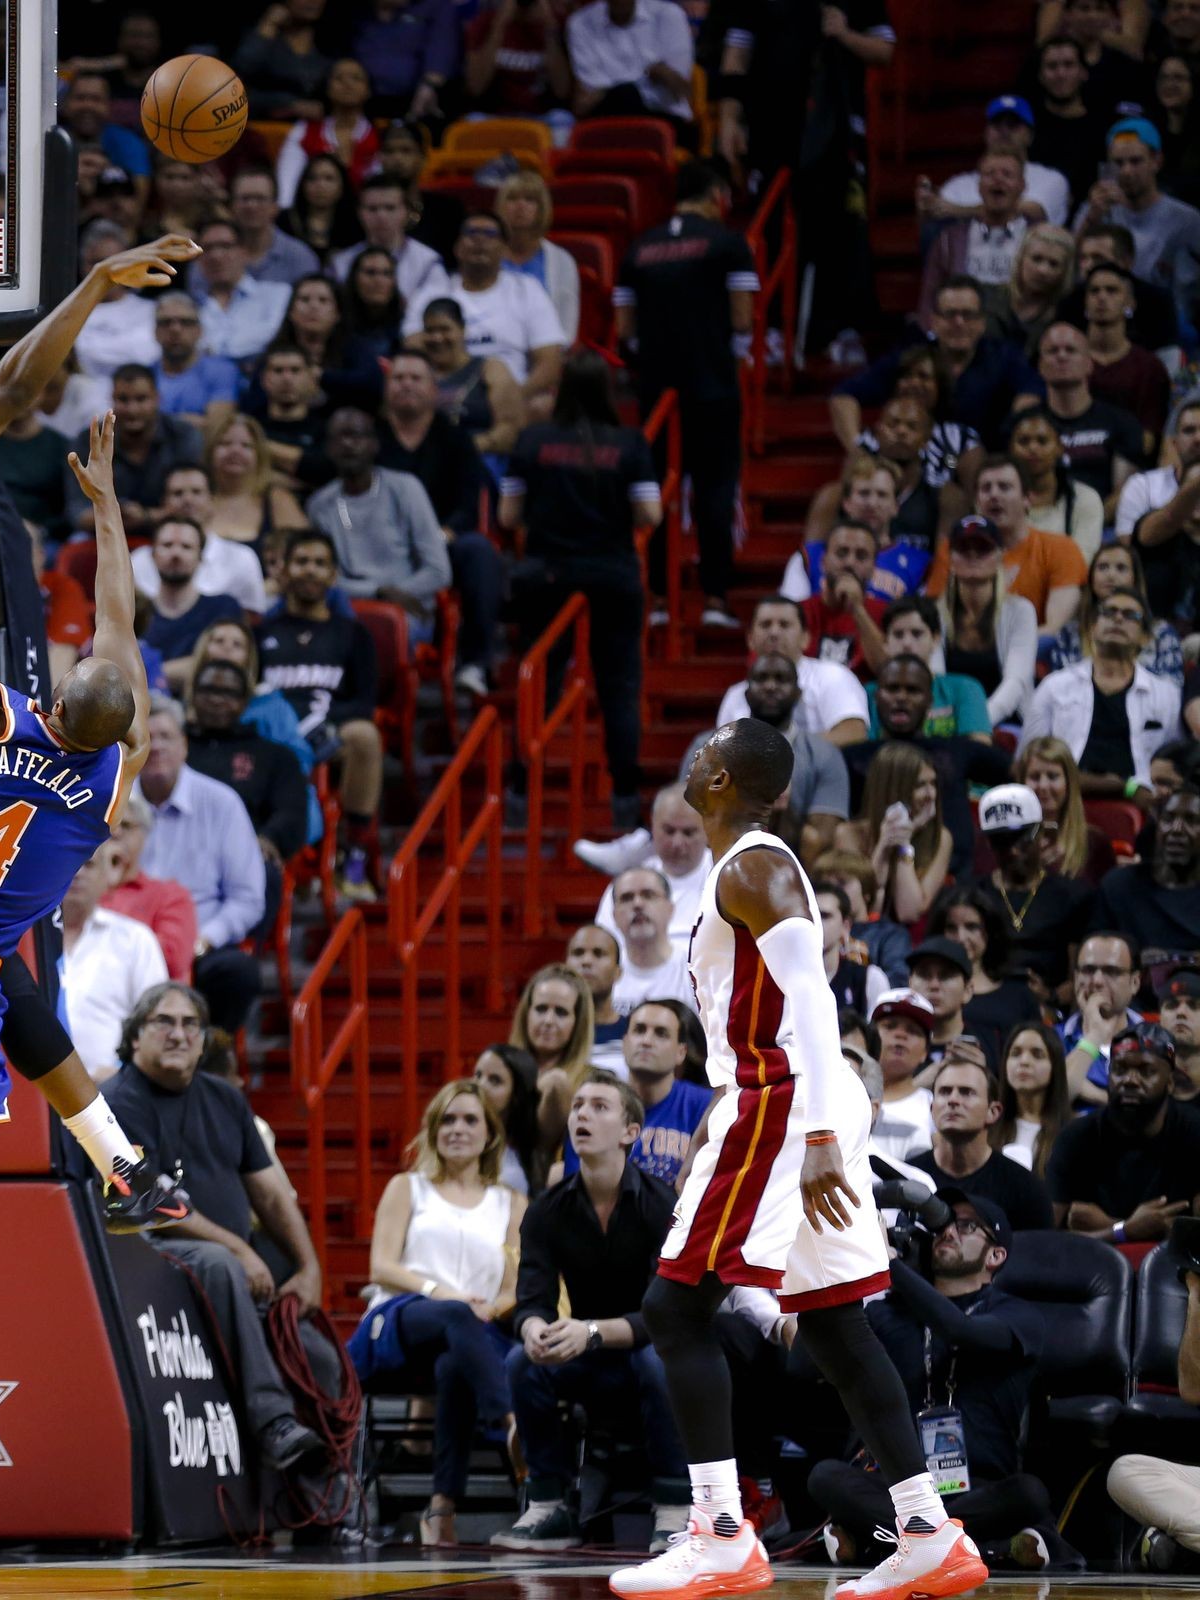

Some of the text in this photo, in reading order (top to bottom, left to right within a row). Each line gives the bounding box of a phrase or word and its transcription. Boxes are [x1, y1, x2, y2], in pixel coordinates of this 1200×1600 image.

[212, 95, 248, 126] SPALD
[163, 1391, 209, 1467] Blue
[940, 1459, 963, 1469] MEDIA
